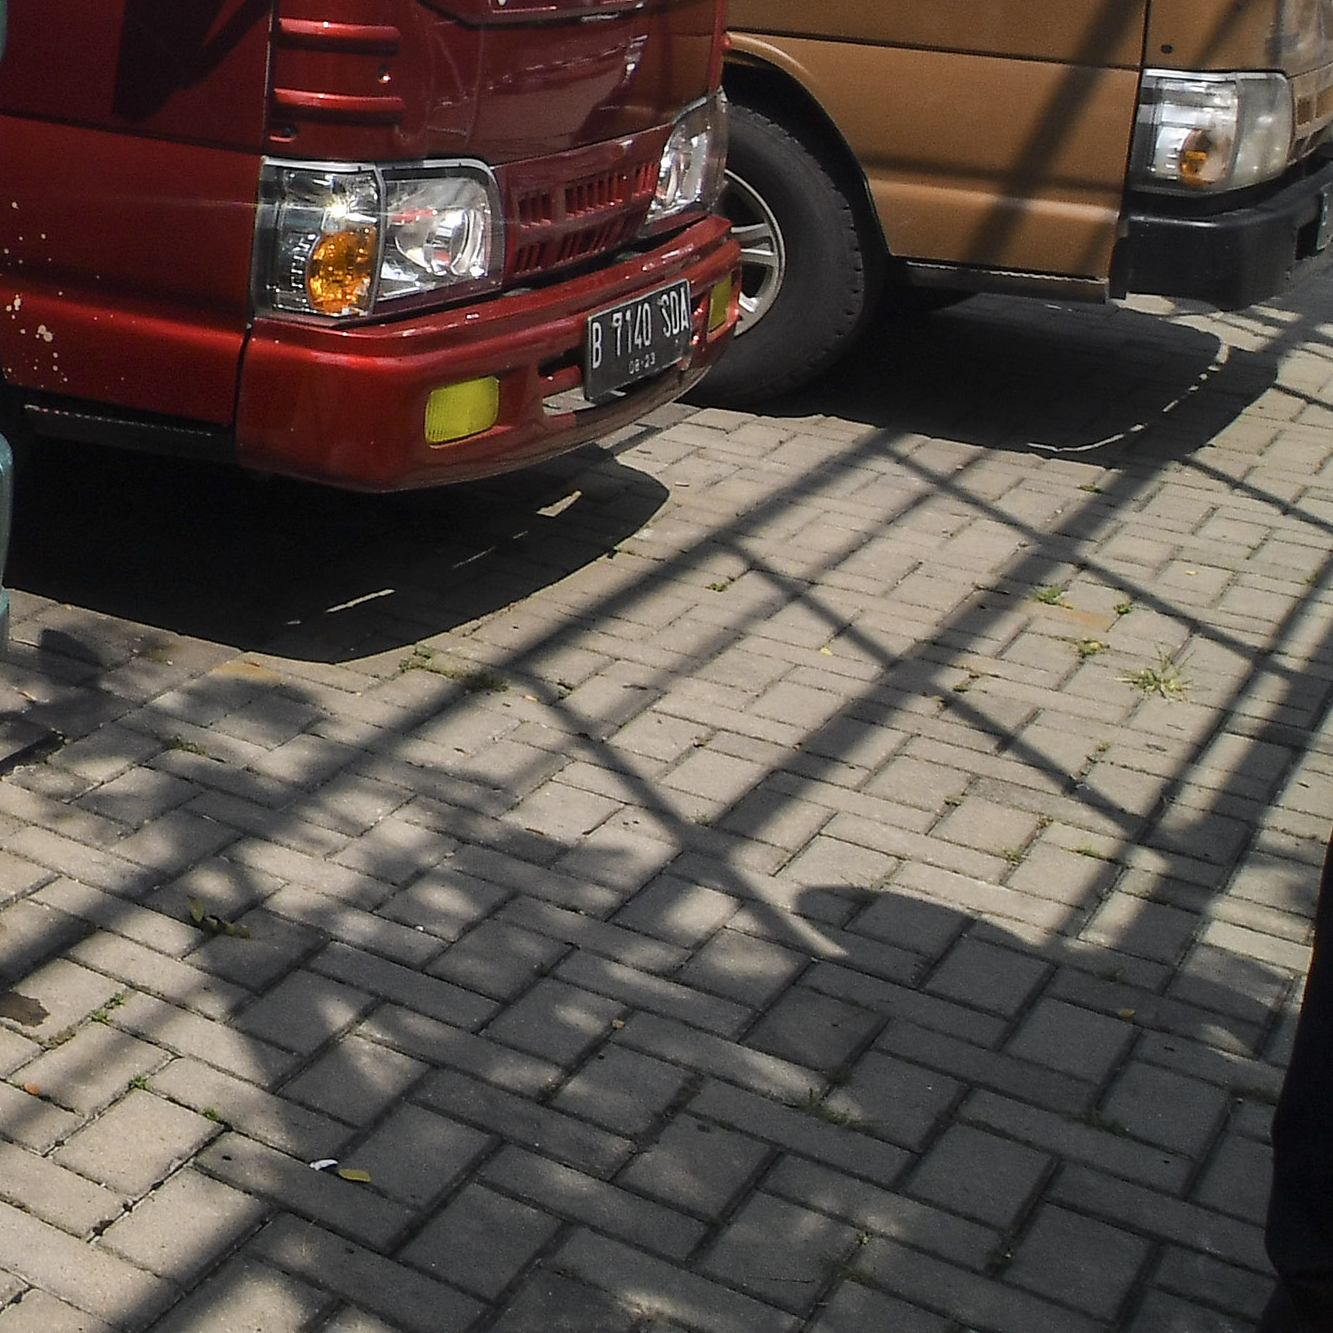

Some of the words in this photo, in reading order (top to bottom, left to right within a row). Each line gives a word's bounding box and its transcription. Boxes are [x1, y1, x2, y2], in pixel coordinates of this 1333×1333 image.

[592, 321, 602, 369] B
[611, 302, 652, 357] 7140
[656, 287, 690, 338] SDA
